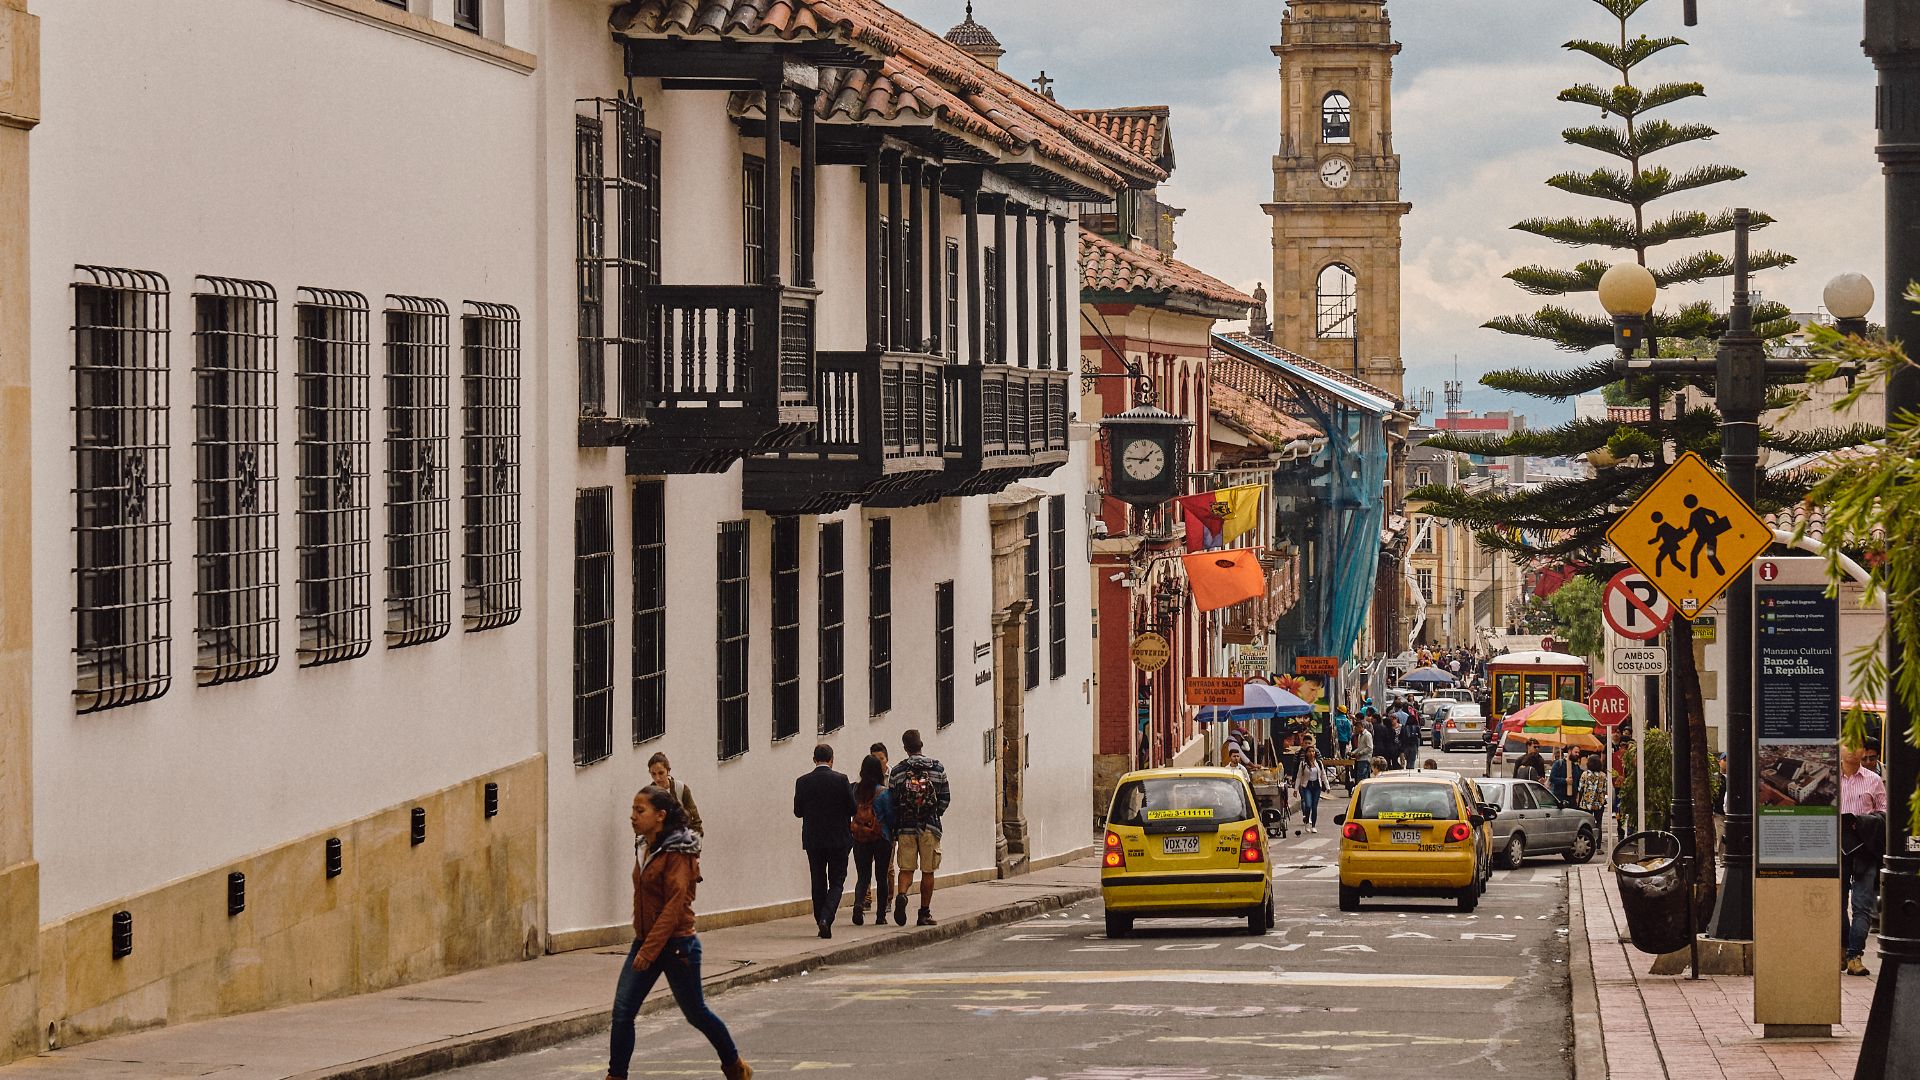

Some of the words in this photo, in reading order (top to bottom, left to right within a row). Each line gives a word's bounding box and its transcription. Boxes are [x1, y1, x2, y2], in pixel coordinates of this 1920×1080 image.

[1625, 581, 1658, 627] P
[1133, 649, 1168, 657] SOUVENIRS
[1799, 647, 1832, 655] Cultural
[1624, 652, 1655, 660] AMBOS
[1763, 657, 1794, 665] Banco
[1796, 656, 1809, 665] de
[1617, 662, 1662, 670] COSTADOS
[1763, 666, 1773, 674] la
[1775, 665, 1825, 677] República
[1593, 698, 1626, 713] PARE
[1164, 838, 1198, 849] VDX-769
[1417, 844, 1436, 852] 21065
[1068, 942, 1379, 953] ZONA
